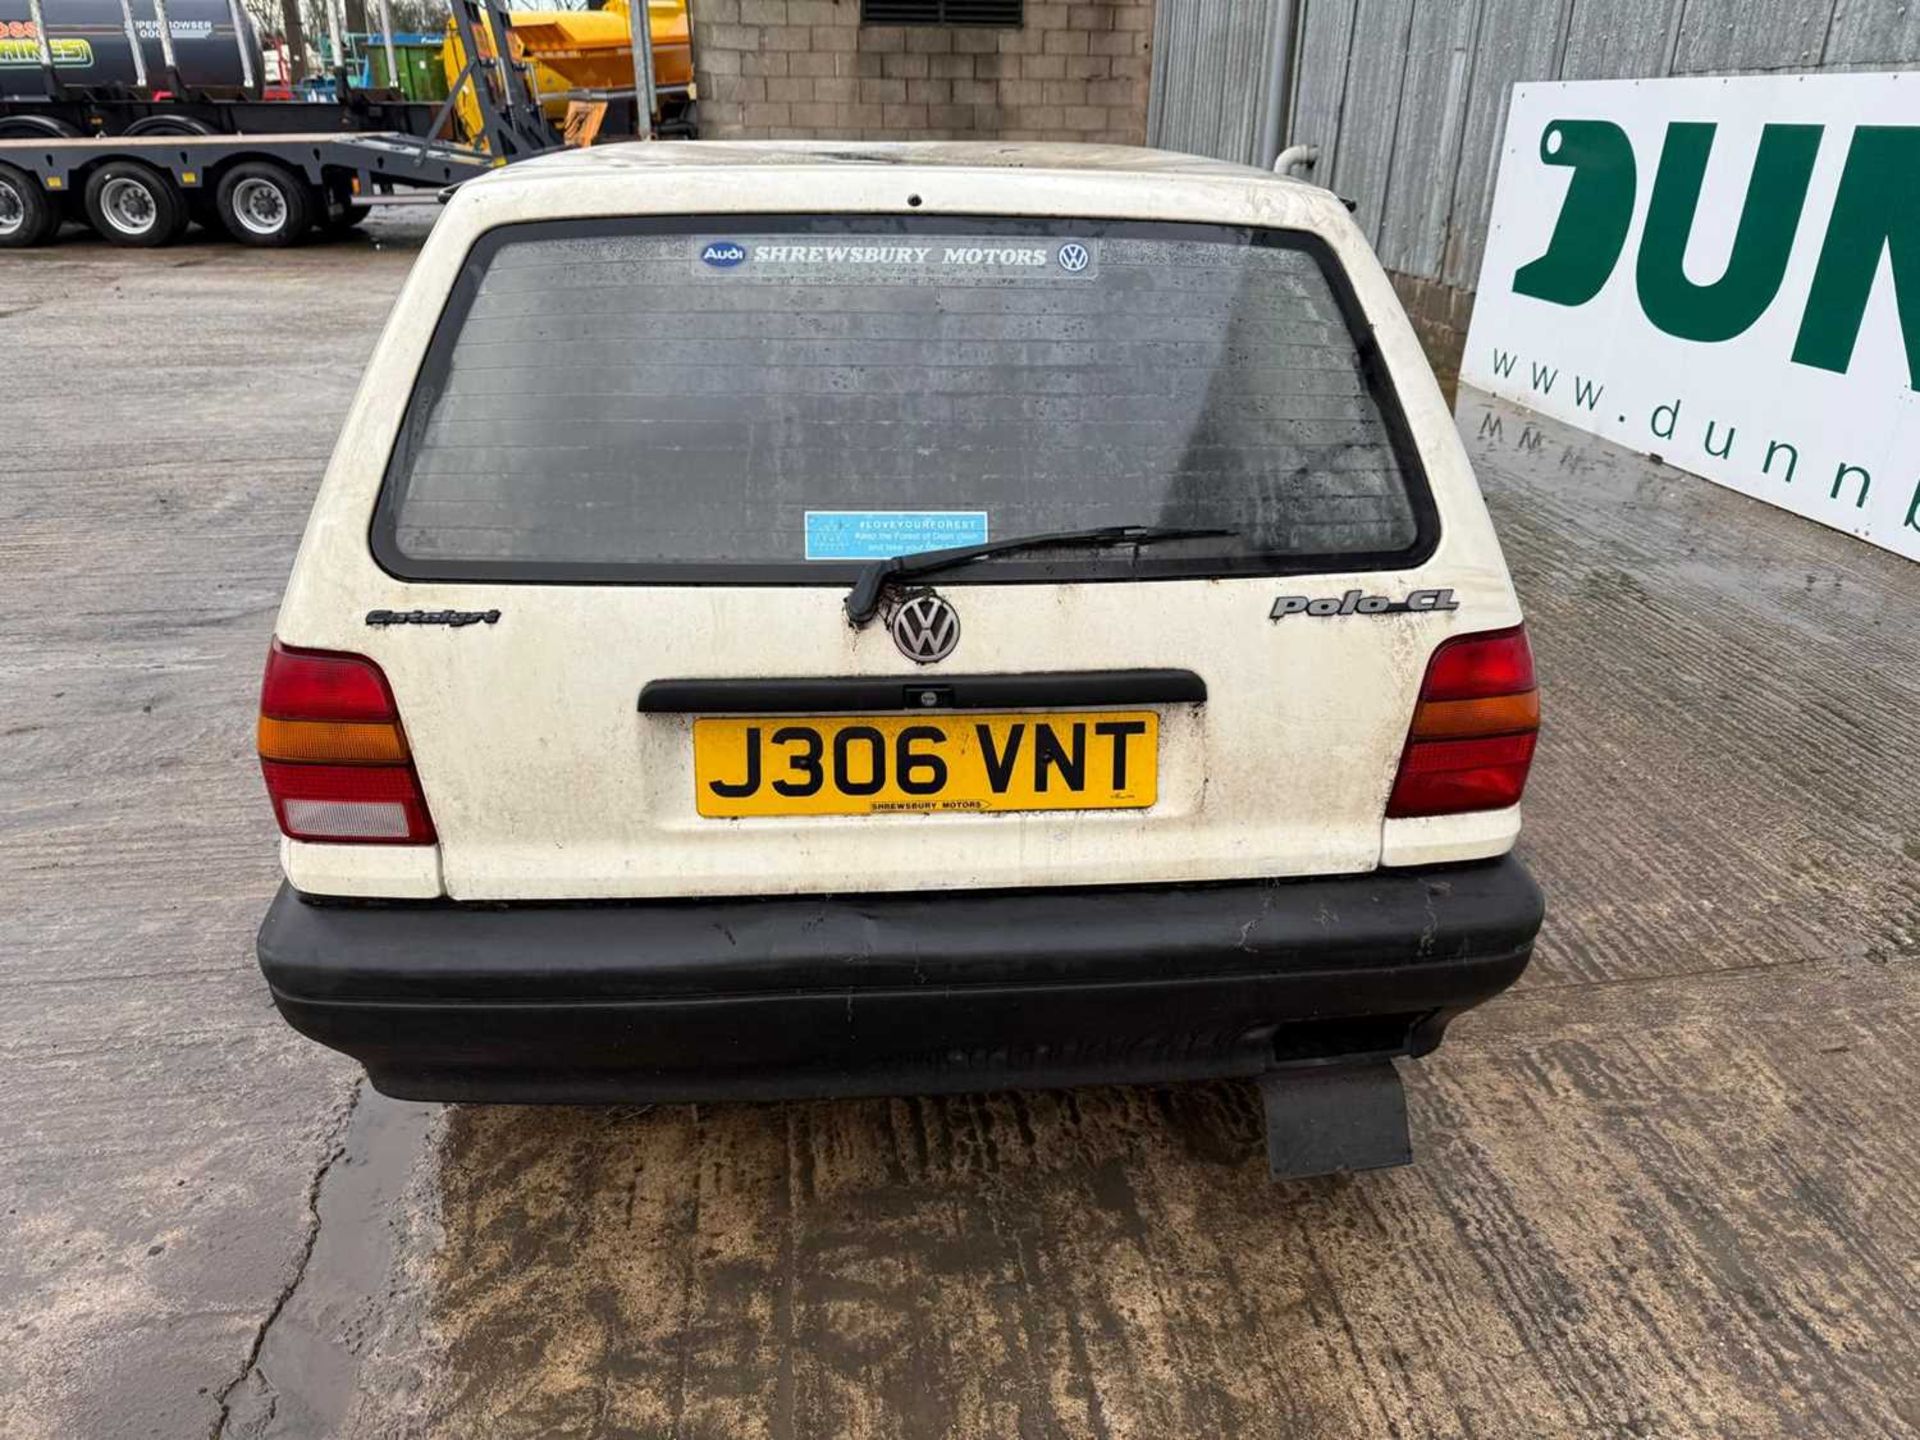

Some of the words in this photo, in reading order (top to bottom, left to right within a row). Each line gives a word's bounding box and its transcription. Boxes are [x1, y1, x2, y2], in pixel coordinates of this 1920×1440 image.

[753, 245, 932, 265] SHREWSBURY
[942, 247, 1047, 266] MOTORS
[1269, 590, 1391, 618] Polo
[1407, 589, 1460, 611] CL
[709, 726, 948, 798] J306
[975, 721, 1146, 794] VNT
[872, 801, 937, 810] SHREWSBURY
[942, 801, 981, 809] MOTORS
